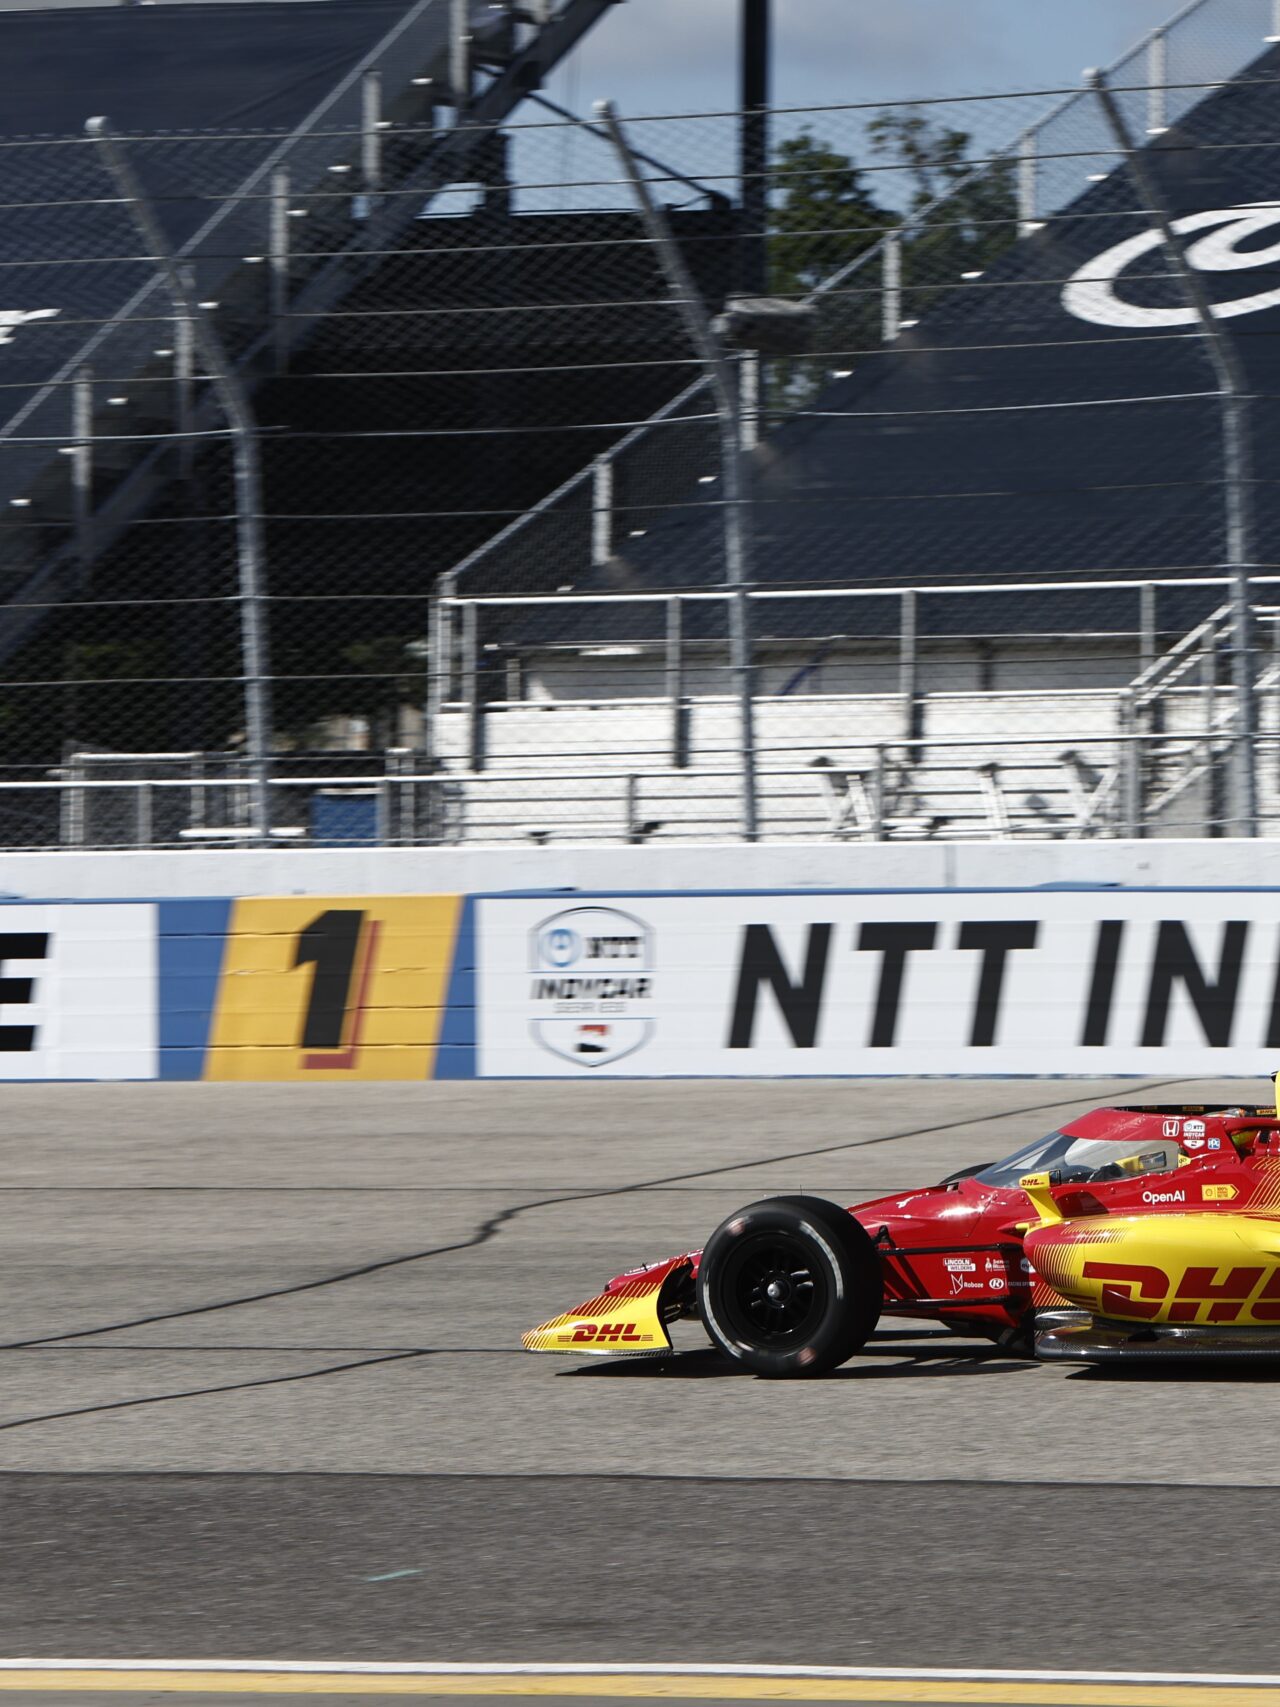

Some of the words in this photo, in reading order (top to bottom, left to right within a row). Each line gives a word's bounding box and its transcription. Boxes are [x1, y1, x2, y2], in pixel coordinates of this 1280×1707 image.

[292, 909, 374, 1055] 1
[728, 920, 1040, 1049] NTT
[1142, 1190, 1186, 1205] OpenAI
[571, 1323, 642, 1342] DHL
